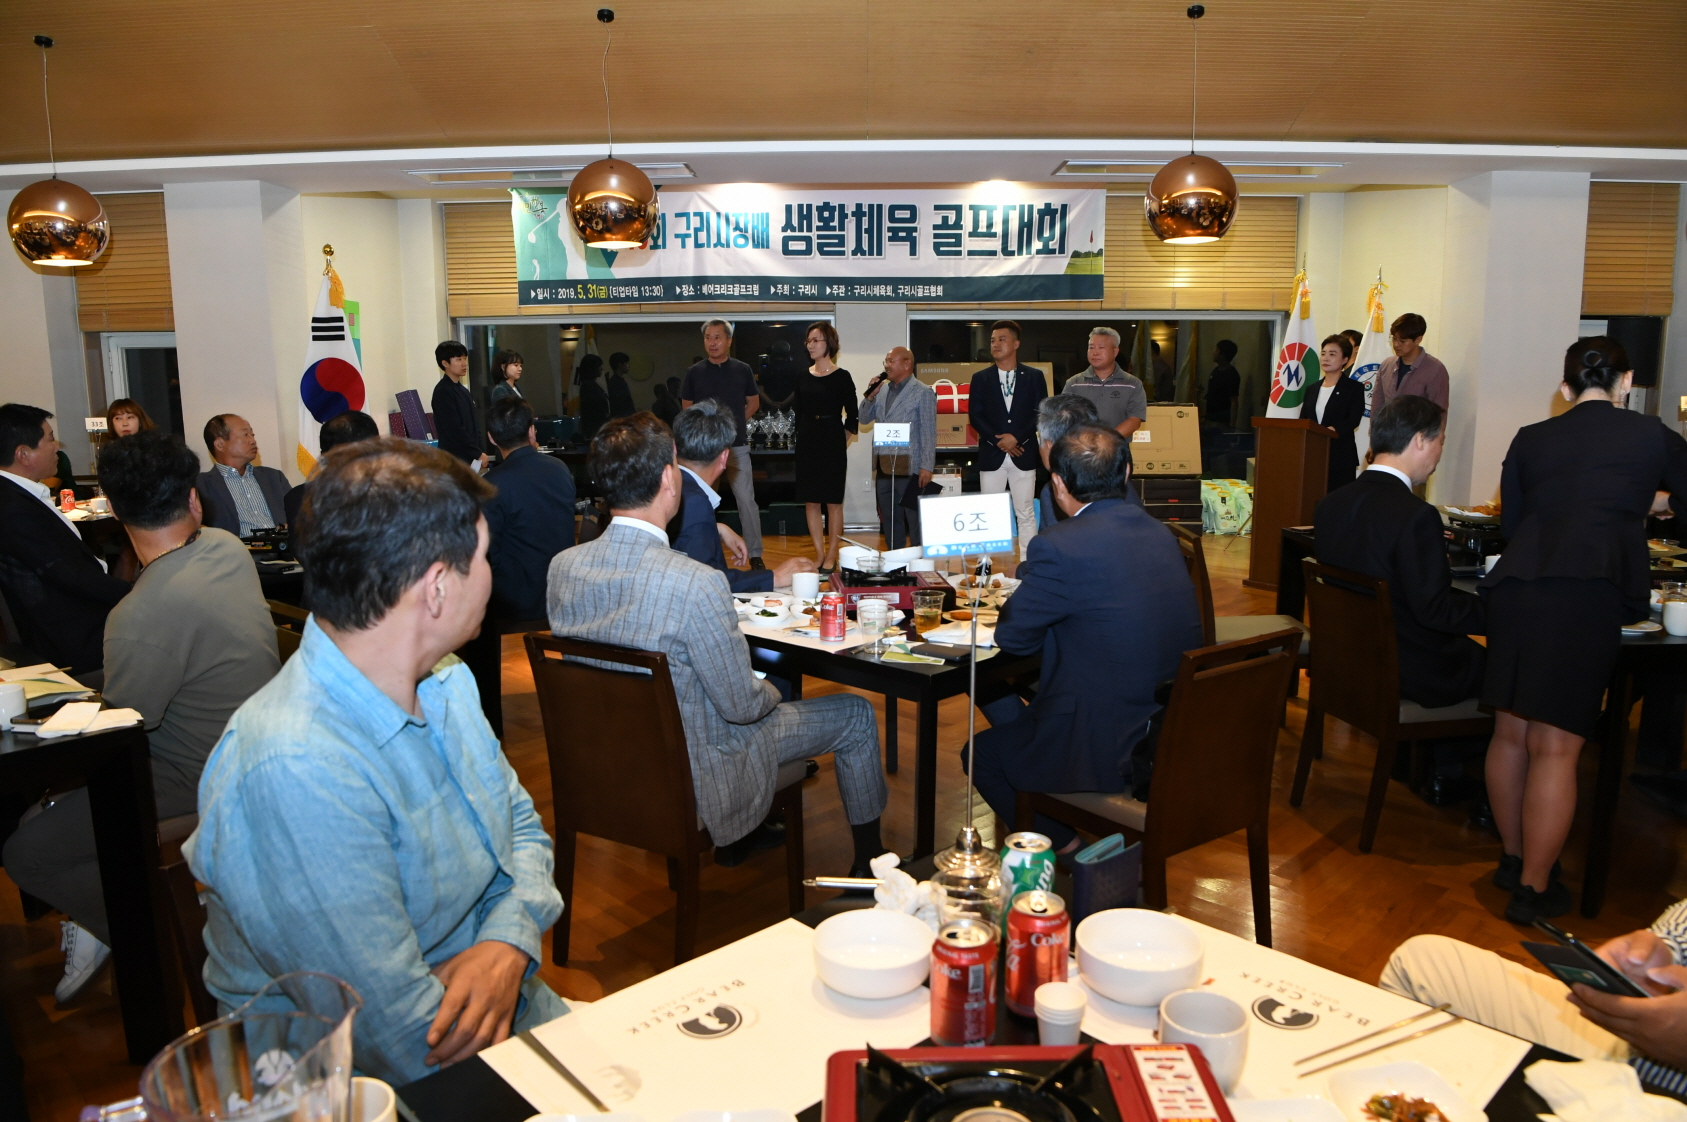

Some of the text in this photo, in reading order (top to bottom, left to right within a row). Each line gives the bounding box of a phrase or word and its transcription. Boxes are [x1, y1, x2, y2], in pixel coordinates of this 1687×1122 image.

[674, 211, 770, 250] 구리시장배
[781, 201, 918, 257] 생활체육
[932, 202, 1069, 257] 골프대회
[537, 288, 550, 299] 일시
[681, 284, 695, 296] 장소
[776, 284, 790, 296] 주최
[798, 284, 818, 296] 구리시
[832, 285, 845, 297] 주관
[886, 429, 901, 438] 2조
[953, 512, 989, 532] 6조
[935, 961, 963, 980] oke
[694, 978, 745, 1004] BEAR
[1311, 998, 1370, 1027] BEAR
